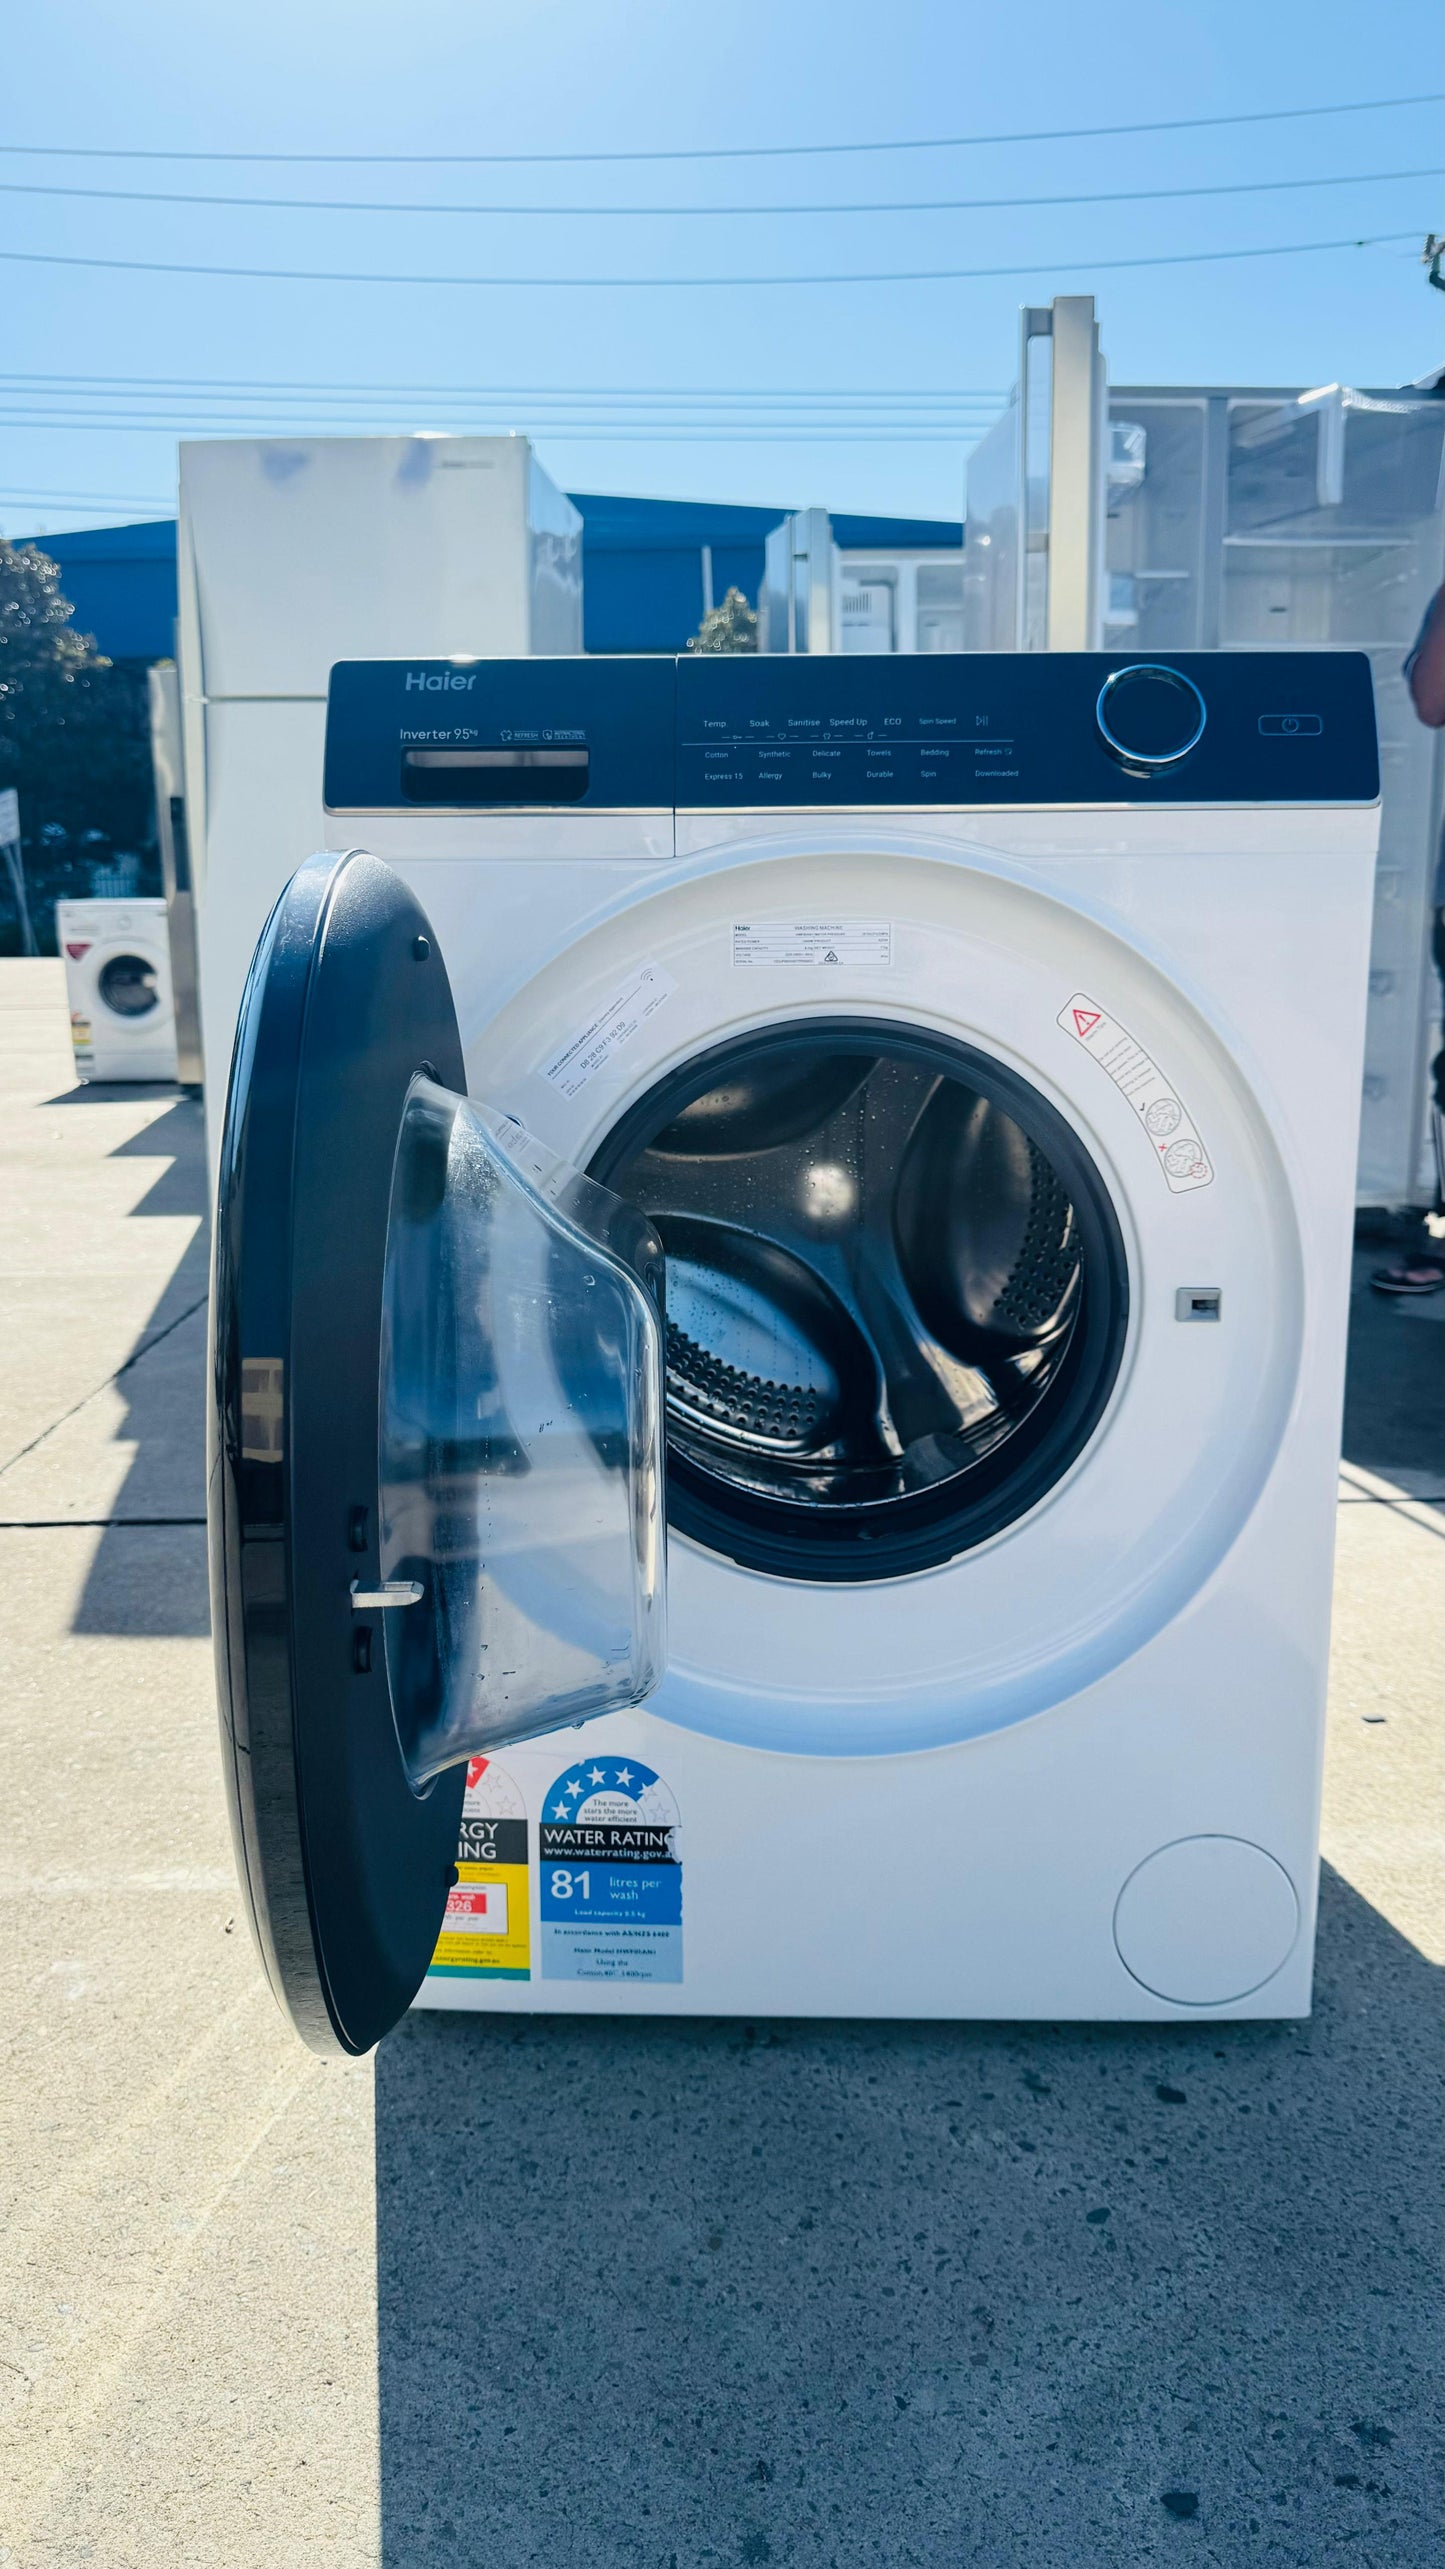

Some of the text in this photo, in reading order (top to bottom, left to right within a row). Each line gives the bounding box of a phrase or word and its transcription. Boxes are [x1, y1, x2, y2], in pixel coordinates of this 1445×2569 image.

[405, 671, 477, 691] Haier
[704, 718, 957, 728] Temp Soak Sanitise Speed Up ECO Spin Speed
[400, 728, 452, 740] Inverter
[758, 751, 791, 759] Synthetic
[920, 749, 950, 757] Bedding
[975, 748, 1002, 756] Refresh
[704, 773, 733, 781] Express
[758, 772, 783, 780] Allergy
[812, 771, 832, 779] Bulky
[920, 770, 937, 778] Spin
[557, 1043, 580, 1067] CONNECTED
[578, 1023, 599, 1045] APPLIANCE
[580, 1059, 590, 1069] D8
[587, 1051, 597, 1061] 28
[595, 1044, 605, 1054] C9
[602, 1037, 612, 1046] F3
[616, 1021, 626, 1032] D9
[593, 1799, 606, 1807] The
[603, 1807, 616, 1815] the
[608, 1815, 637, 1823] efficient
[459, 1822, 499, 1840] RGY
[544, 1829, 606, 1845] WATER
[458, 1841, 497, 1859] ING
[544, 1847, 673, 1860] www.waterrating.gov.a
[551, 1869, 590, 1899] 81
[609, 1876, 662, 1891] litres per
[609, 1890, 639, 1901] wash
